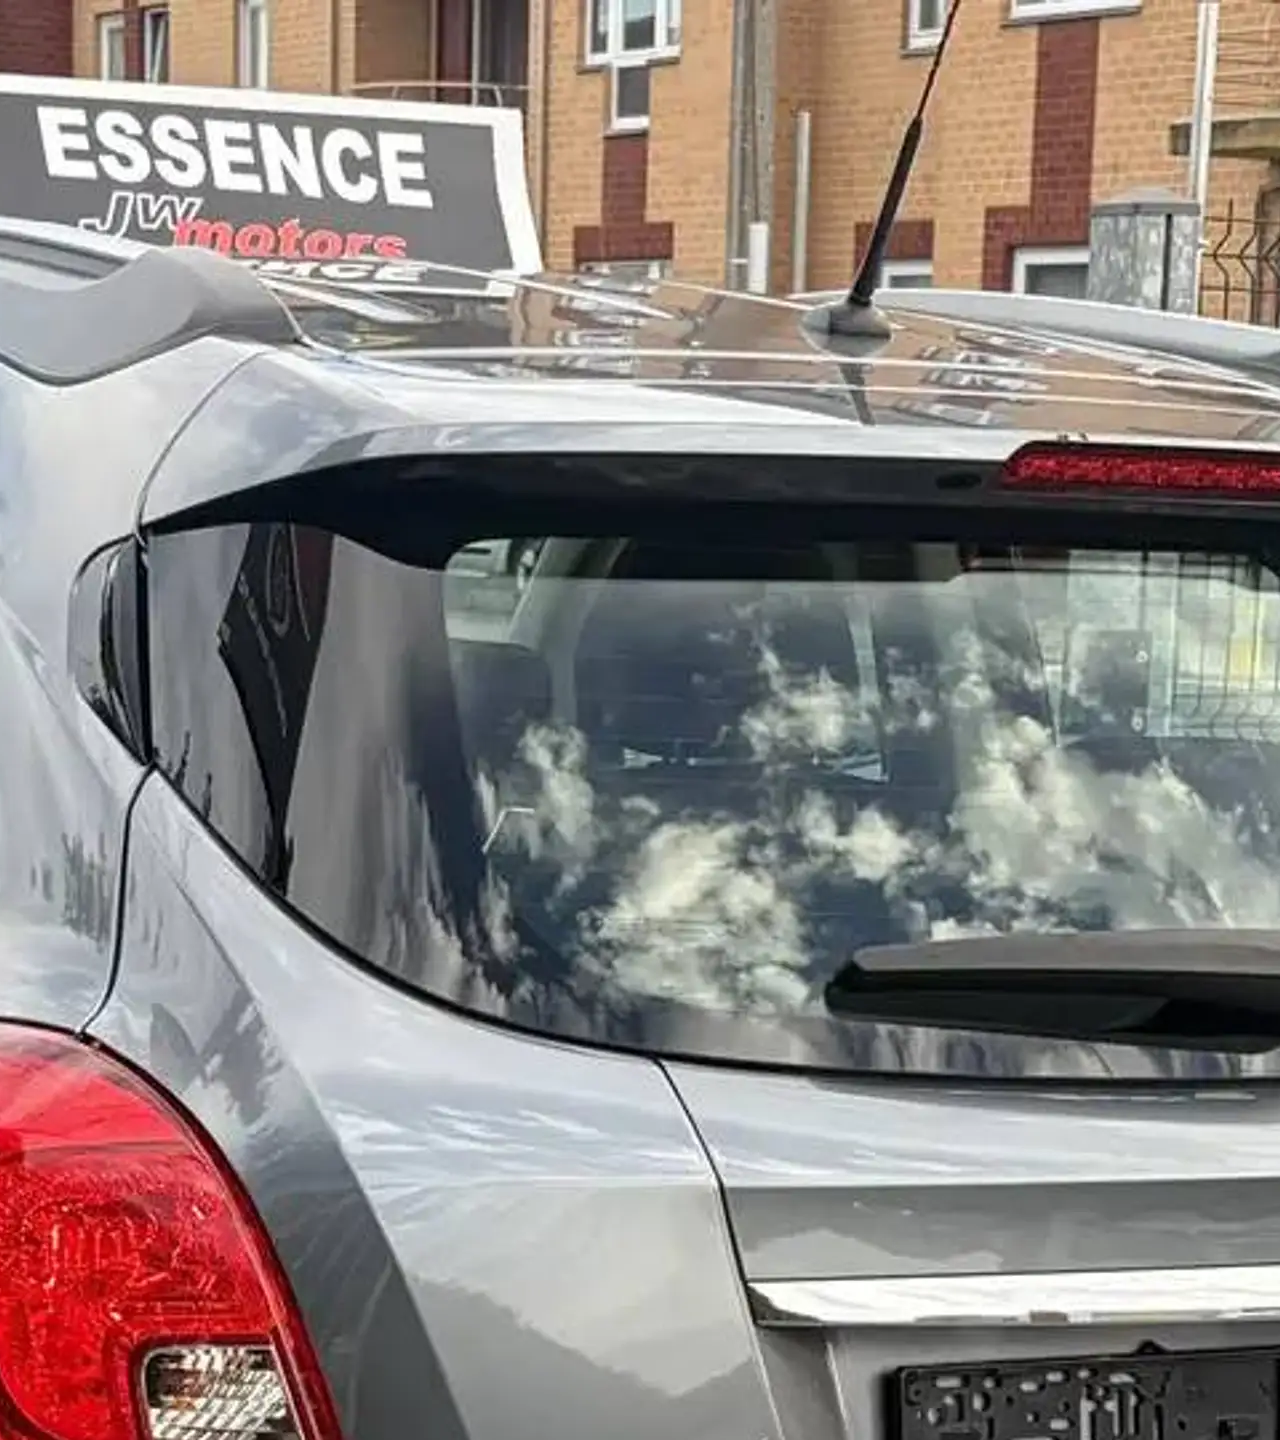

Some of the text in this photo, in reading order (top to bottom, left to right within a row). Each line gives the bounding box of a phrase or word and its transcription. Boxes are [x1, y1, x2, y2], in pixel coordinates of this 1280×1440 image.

[37, 106, 433, 209] ESSENCE
[78, 192, 408, 259] JW motors
